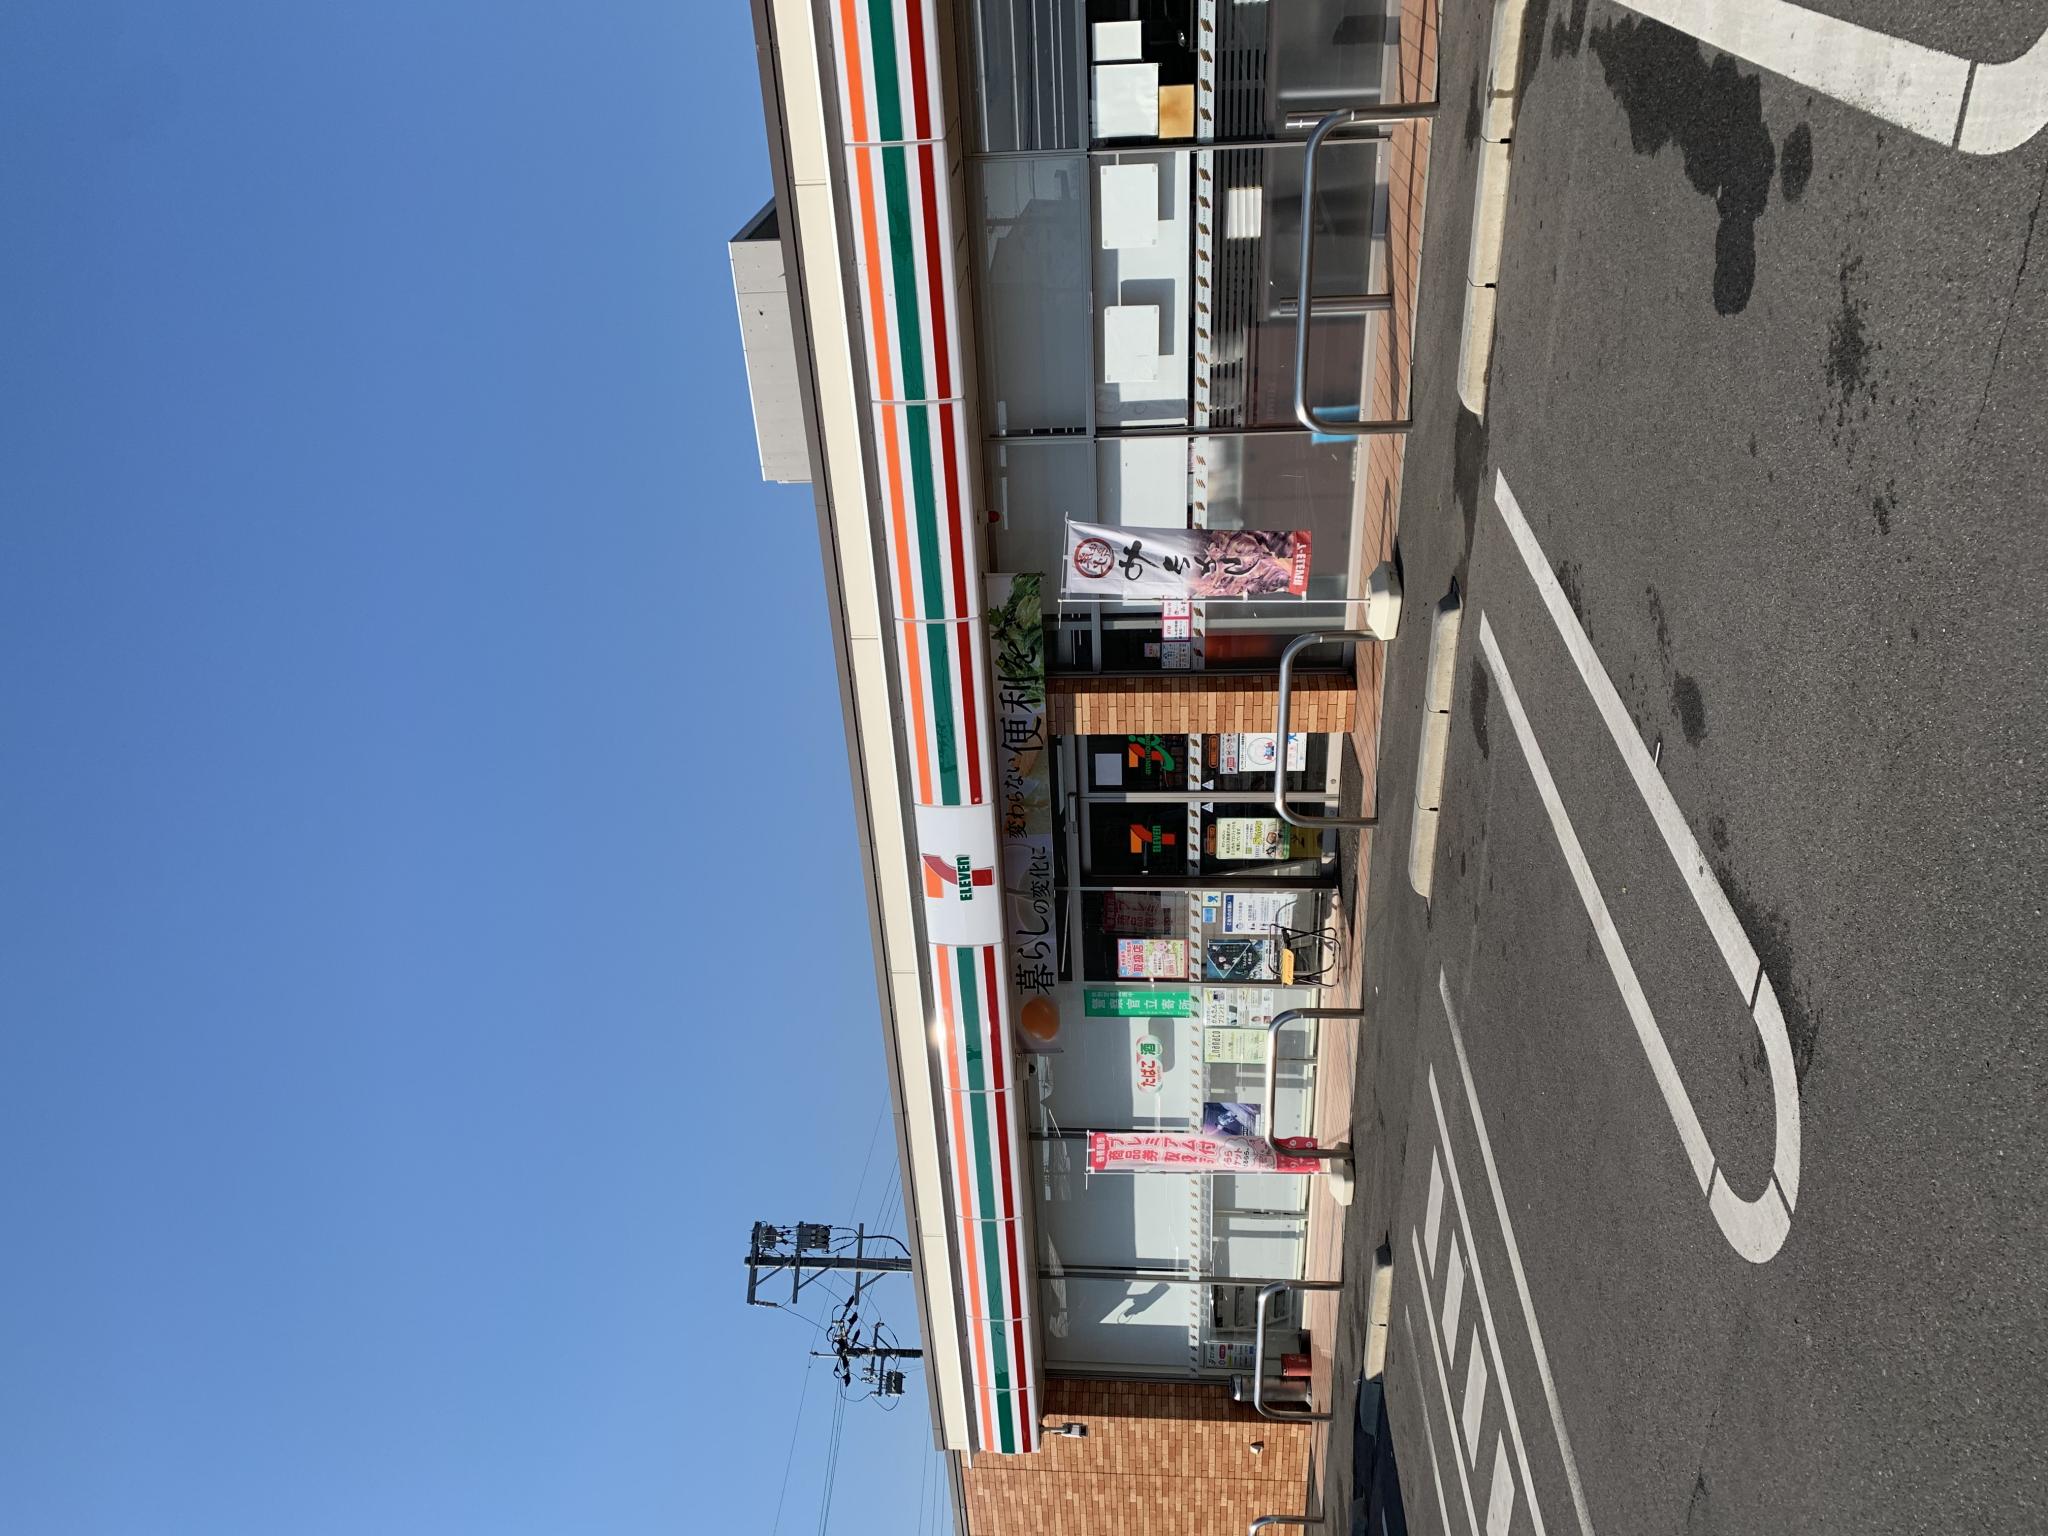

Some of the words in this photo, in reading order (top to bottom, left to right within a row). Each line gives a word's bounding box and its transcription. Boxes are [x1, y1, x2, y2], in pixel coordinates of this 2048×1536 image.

[1003, 758, 1028, 839] 変わらない
[1128, 823, 1176, 853] 7
[921, 853, 995, 898] 7
[1015, 846, 1056, 995] 暮らしの変化に
[1133, 943, 1144, 973] 取扱店
[1091, 998, 1193, 1010] 警察官立寄所
[1140, 1043, 1156, 1055] 酒
[1140, 1060, 1156, 1087] たばこ
[1107, 1137, 1216, 1155] プレミアム付
[1108, 1149, 1159, 1162] 商品券
